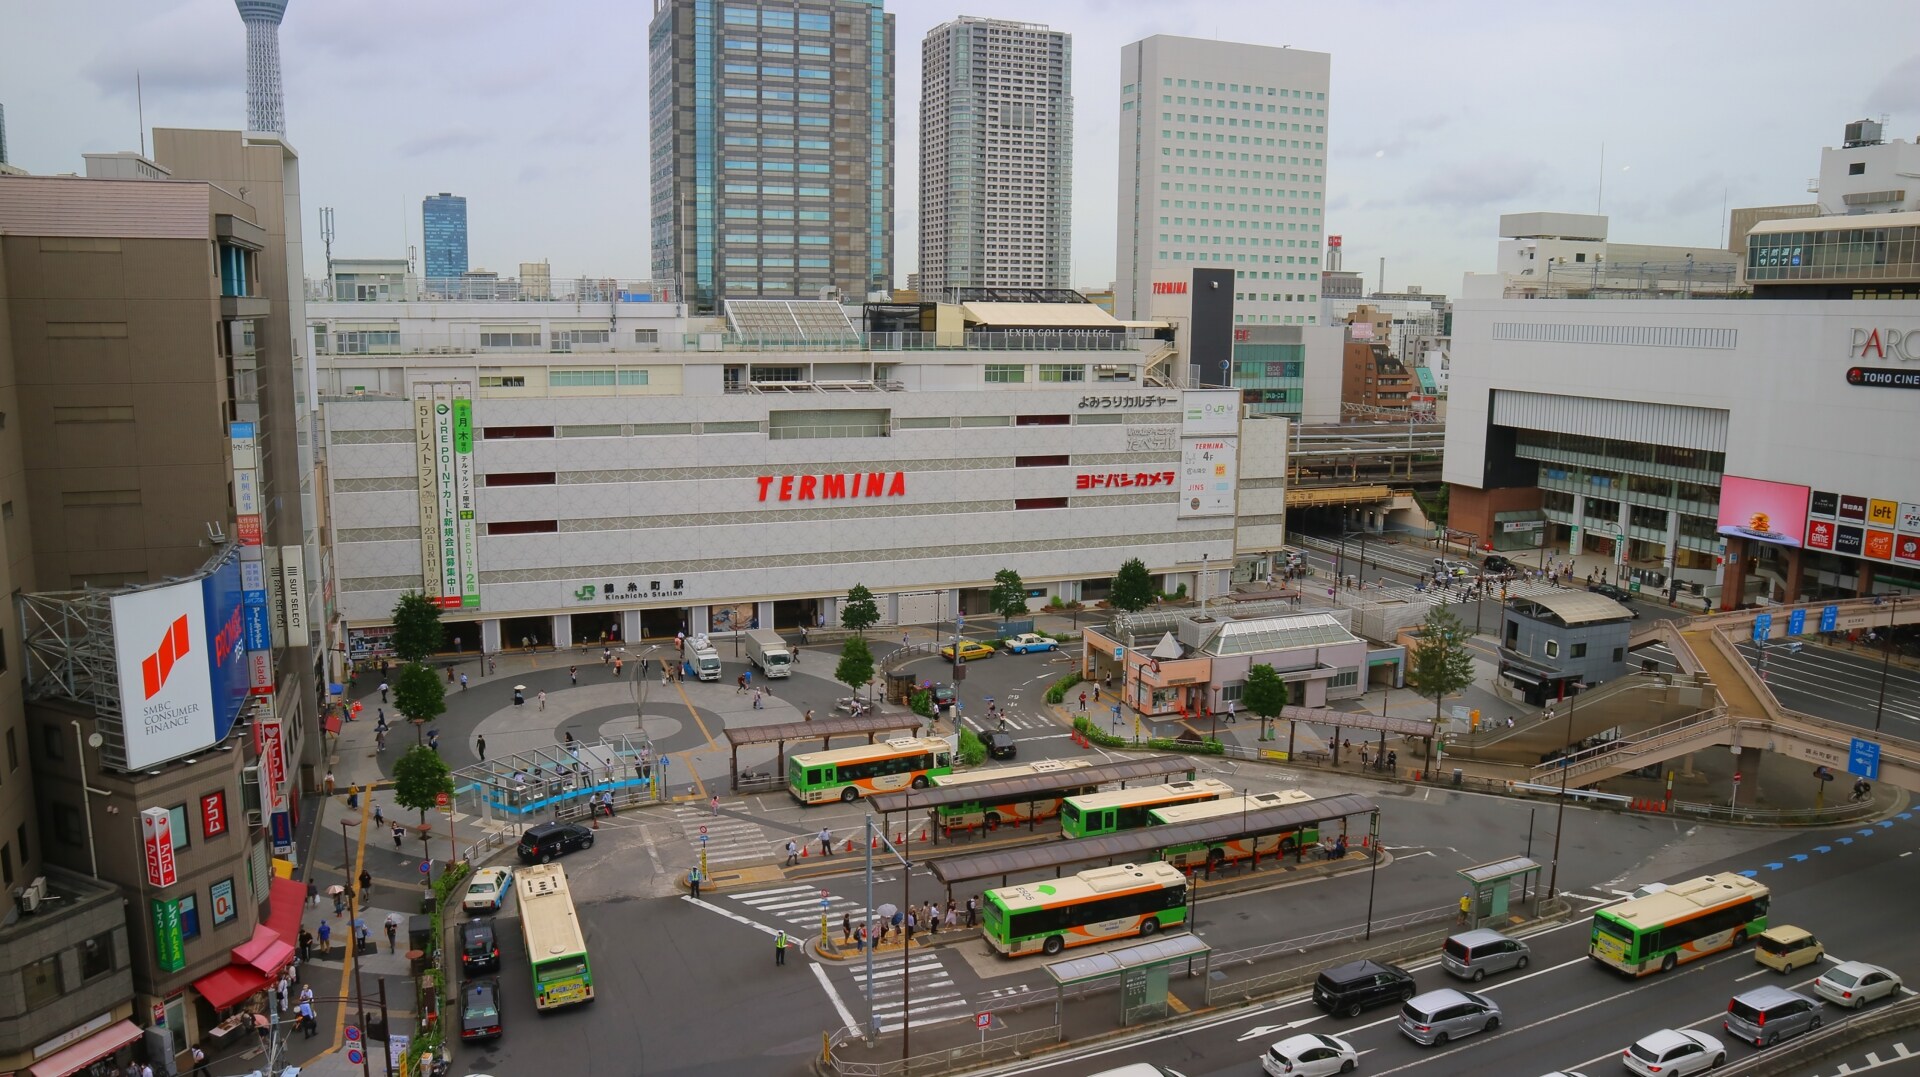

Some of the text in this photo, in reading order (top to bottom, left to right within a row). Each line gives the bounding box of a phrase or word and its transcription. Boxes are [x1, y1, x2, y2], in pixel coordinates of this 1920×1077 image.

[1760, 248, 1800, 256] 天然温泉
[1760, 257, 1788, 266] サウナ
[1153, 282, 1187, 294] TERMINA
[1038, 329, 1062, 338] GOLF
[1067, 329, 1110, 338] COLLEGE
[1863, 372, 1920, 385] TOHO CINE
[1078, 395, 1178, 409] よみうりカルチャー
[440, 418, 448, 443] JRE
[420, 406, 433, 489] 5Fレストラン
[757, 471, 905, 502] TERMINA
[1076, 472, 1175, 489] ヨドバシカメラ
[575, 585, 596, 597] JR
[604, 580, 684, 593] 錦糸町駅
[290, 578, 300, 628] SUIT SELECT
[256, 655, 266, 685] salada
[143, 701, 171, 716] SMBC
[144, 703, 199, 726] CONSUMER
[145, 716, 190, 736] FINANCE
[1855, 741, 1875, 754] 押上
[207, 796, 221, 833] アコム
[148, 844, 159, 878] アコム
[160, 843, 173, 873] アコム
